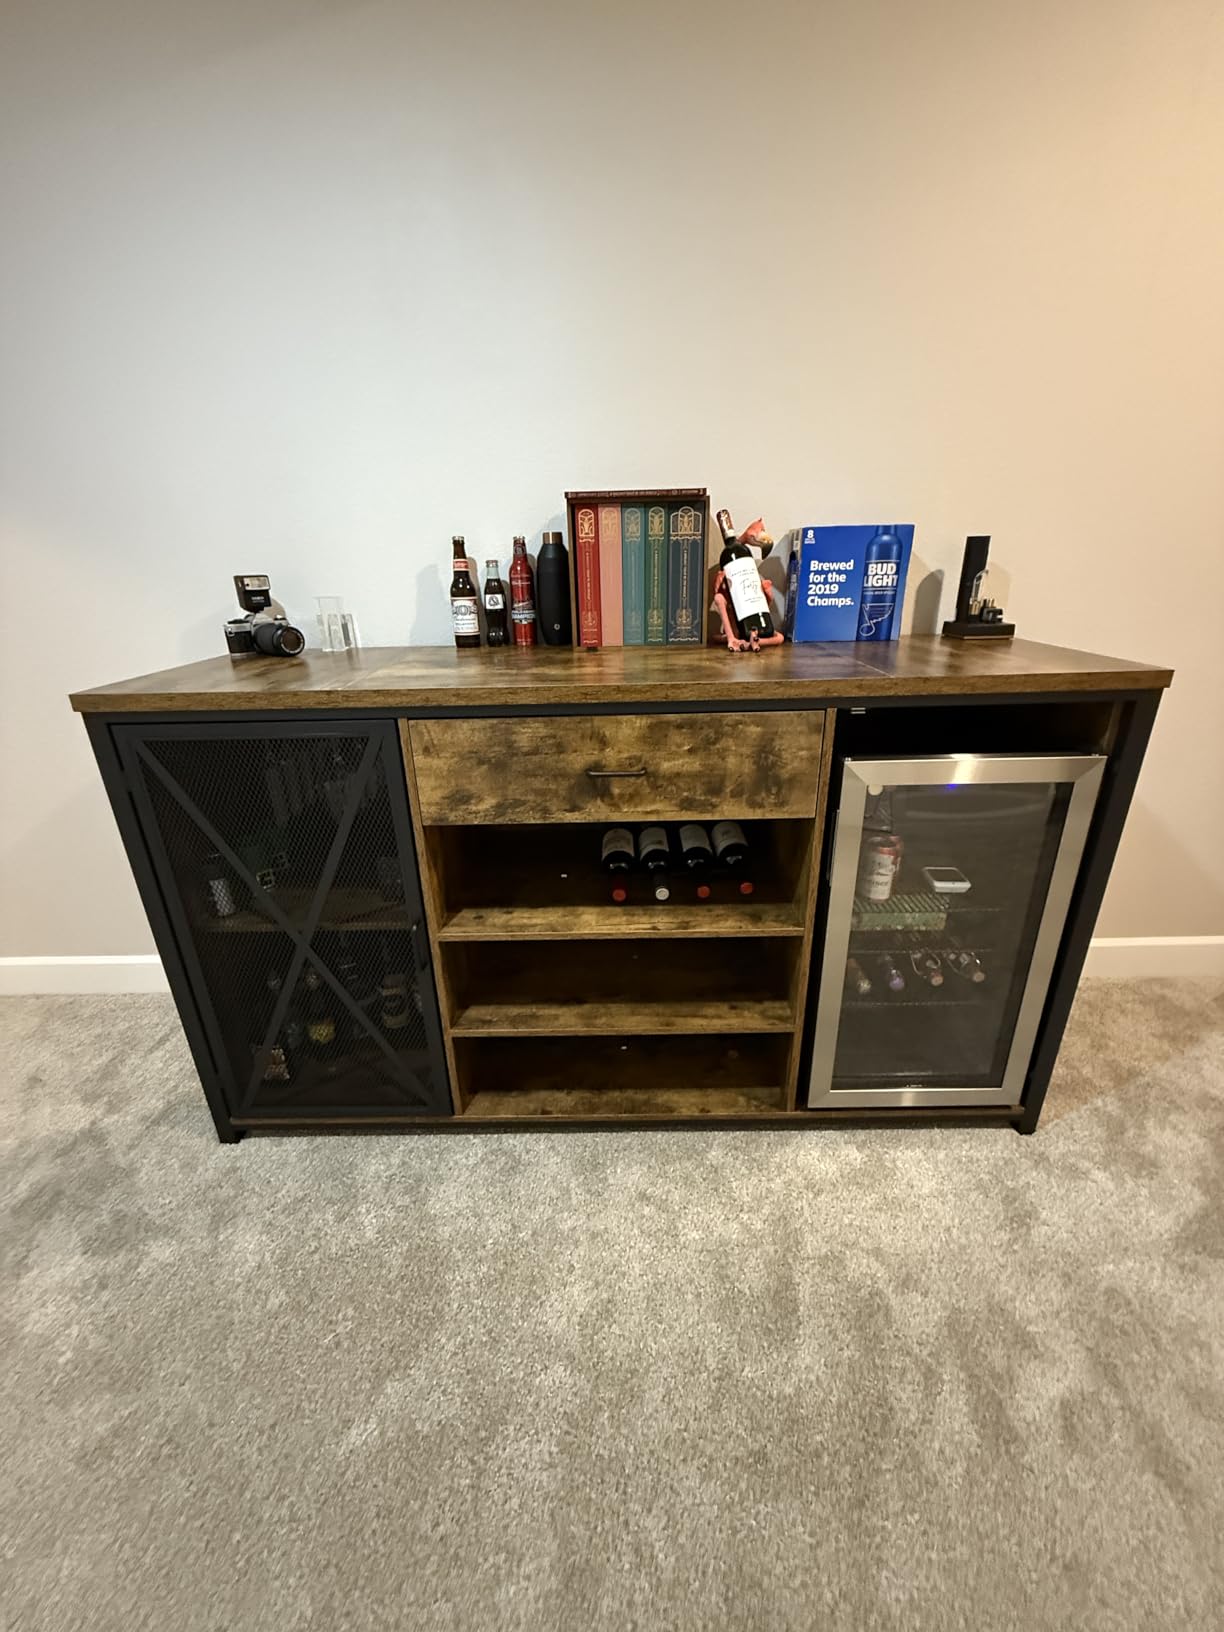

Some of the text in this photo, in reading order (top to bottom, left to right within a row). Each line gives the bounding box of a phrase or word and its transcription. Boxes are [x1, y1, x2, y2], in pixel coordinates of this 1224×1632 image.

[807, 529, 815, 538] 8
[810, 559, 855, 571] Brewed
[868, 563, 896, 575] BUD
[808, 572, 847, 583] for the
[863, 575, 899, 587] LIGHT
[807, 584, 839, 595] 2019
[807, 596, 855, 608] Champs.
